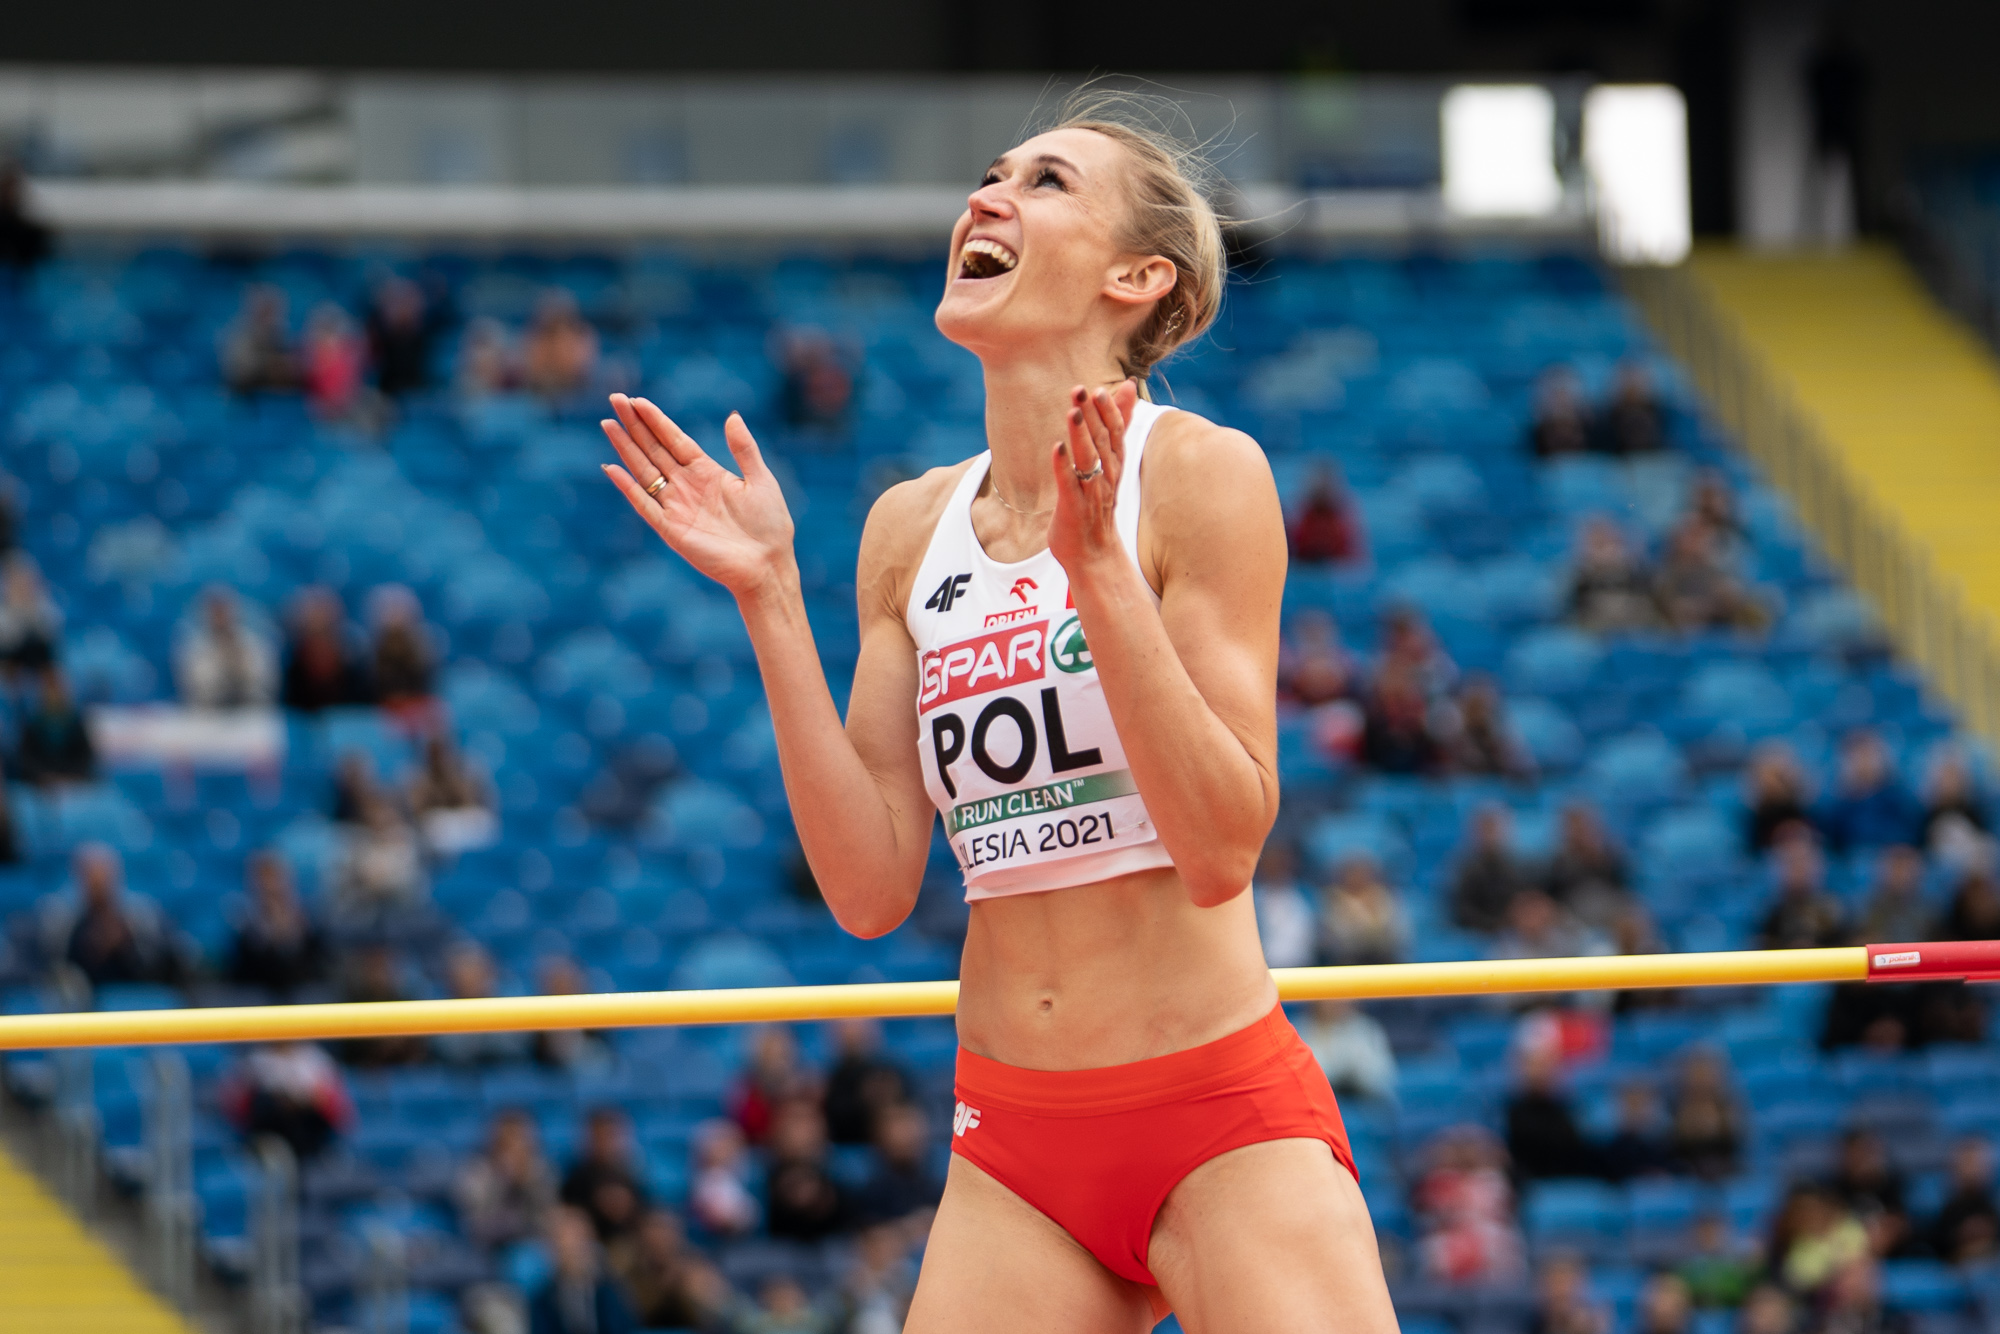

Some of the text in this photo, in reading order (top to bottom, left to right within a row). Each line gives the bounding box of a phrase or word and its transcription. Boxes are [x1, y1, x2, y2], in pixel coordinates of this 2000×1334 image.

[925, 573, 972, 612] 4F
[921, 630, 1042, 704] SPAR
[932, 687, 1103, 799] POL
[962, 799, 1002, 826] RUN
[1038, 811, 1115, 852] 2021
